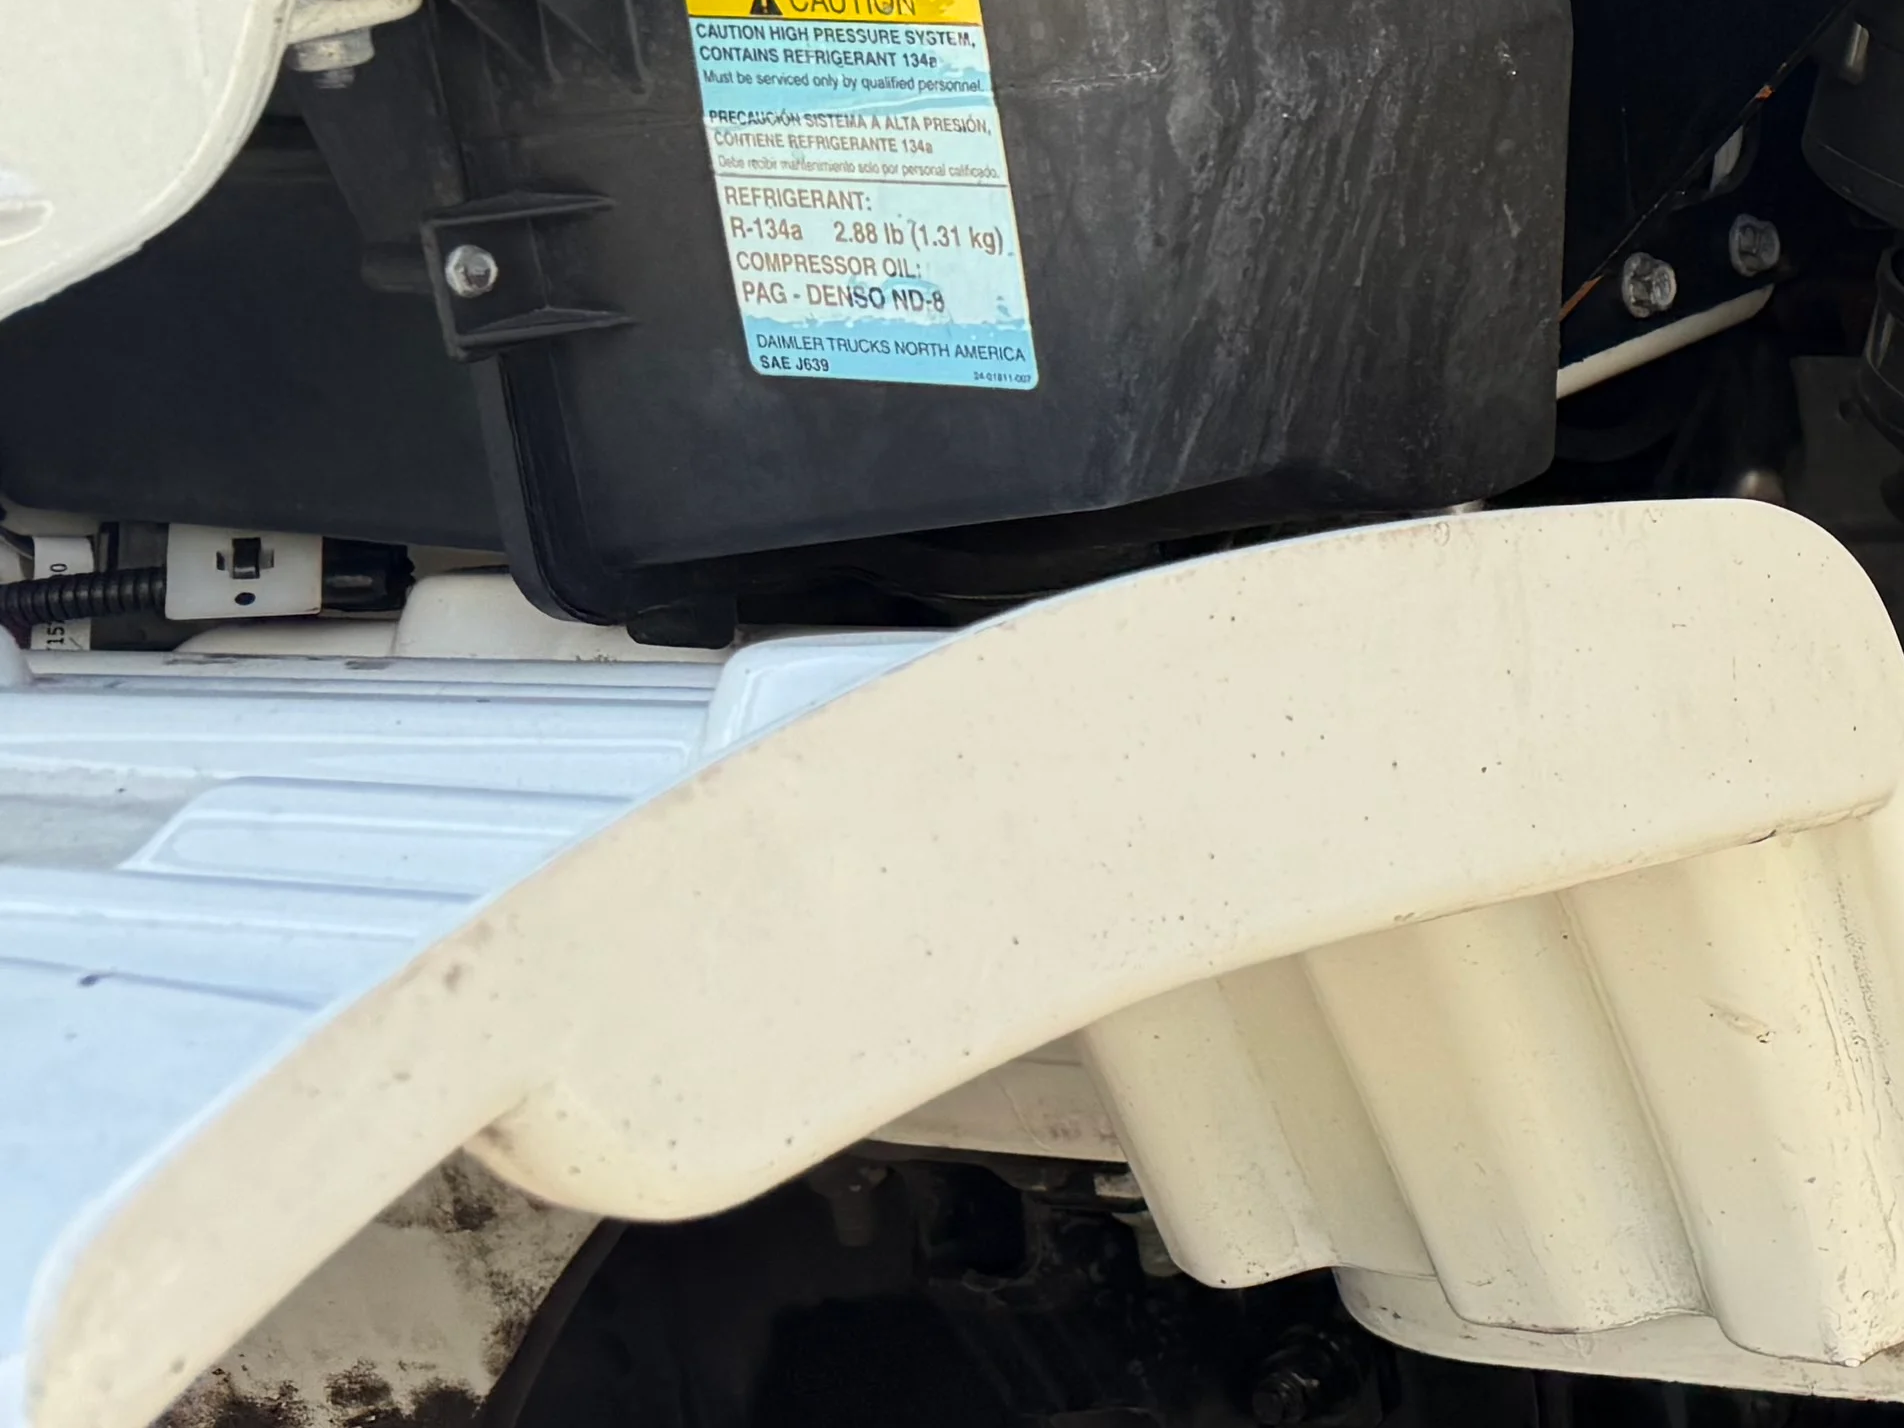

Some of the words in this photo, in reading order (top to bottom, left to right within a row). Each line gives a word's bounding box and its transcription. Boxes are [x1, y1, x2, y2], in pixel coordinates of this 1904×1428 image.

[696, 24, 765, 41] CAUTION
[769, 26, 809, 42] HIGH
[813, 28, 901, 45] PRESSURE
[905, 30, 976, 48] SYSTEM,
[700, 47, 780, 63] CONTAINS
[784, 49, 897, 67] REFRIGERANT
[902, 52, 938, 67] 134a
[704, 71, 733, 85] Must
[737, 72, 753, 86] be
[757, 73, 809, 87] serviced
[813, 75, 840, 90] only
[843, 76, 859, 91] by
[862, 76, 914, 92] qualified
[918, 78, 984, 93] personnel.
[806, 112, 866, 129] SISTEMA
[871, 115, 881, 130] A
[886, 116, 920, 131] ALTA
[924, 115, 990, 136] PRESIÓN,
[714, 132, 784, 149] CONTIENE
[789, 134, 897, 153] REFRIGERANTE
[902, 139, 933, 154] 134a
[718, 155, 744, 169] Debe
[747, 156, 778, 170] recibir
[781, 157, 855, 173] mantenimiento
[883, 162, 899, 176] por
[902, 163, 945, 178] personal
[949, 165, 999, 180] calificado.
[725, 186, 872, 211] REFRIGERANT:
[731, 218, 803, 240] R-134a
[834, 221, 878, 244] 2.88
[885, 222, 904, 245] lb
[911, 220, 961, 251] (1.31
[970, 227, 1003, 255] kg)
[737, 251, 877, 276] COMPRESSOR
[882, 257, 921, 278] OIL:
[743, 281, 786, 304] PAG
[807, 284, 885, 310] DENSO
[892, 289, 944, 313] ND-8
[756, 335, 824, 351] DAIMLER
[828, 338, 890, 354] TRUCKS
[895, 340, 950, 357] NORTH
[955, 344, 1025, 362] AMERICA
[760, 355, 791, 369] SAE
[795, 357, 829, 372] J639
